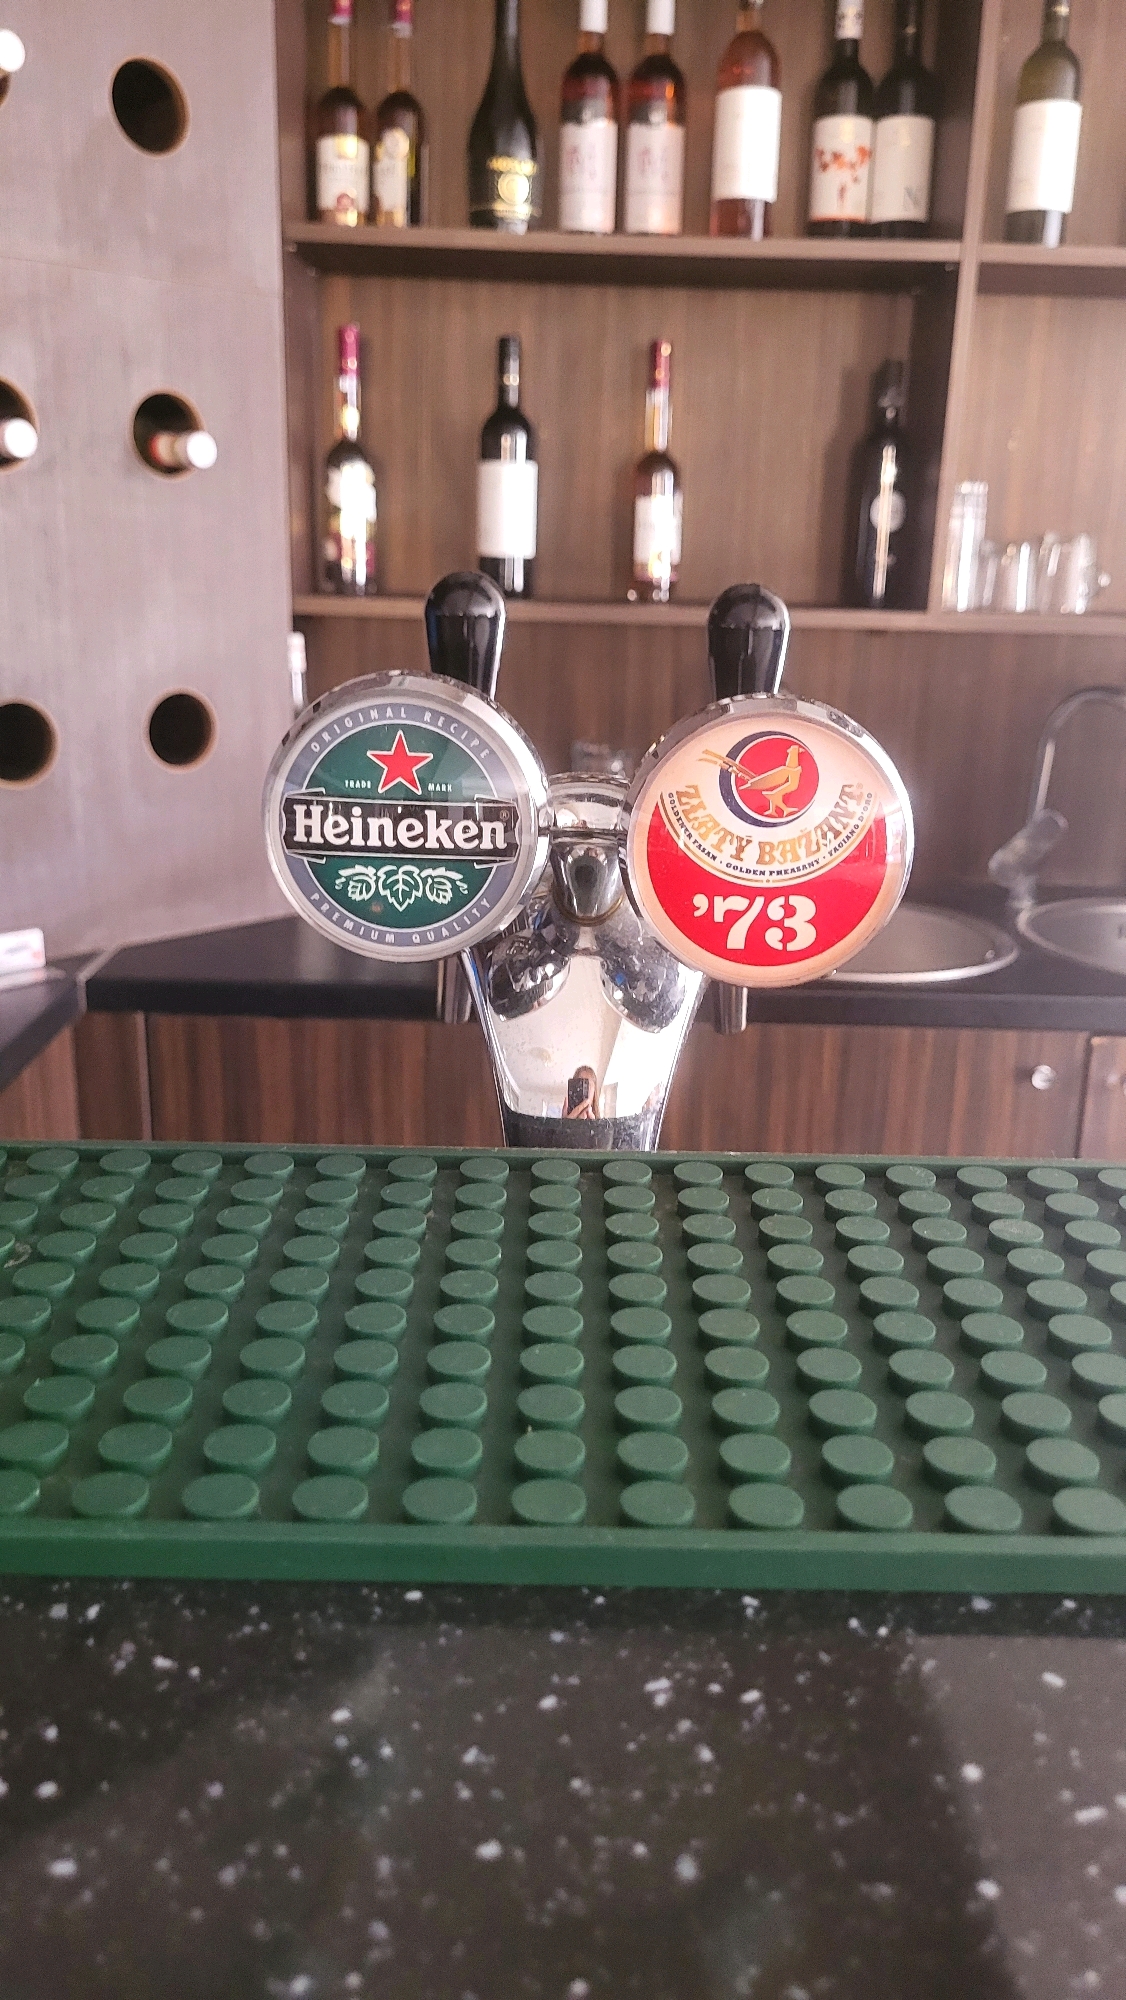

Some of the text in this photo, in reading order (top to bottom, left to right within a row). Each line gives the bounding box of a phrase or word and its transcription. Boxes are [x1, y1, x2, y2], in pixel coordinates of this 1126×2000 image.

[310, 706, 490, 759] ORIGINAL RECIPE
[344, 779, 453, 792] TRADE MARK
[292, 803, 508, 850] Heineken
[692, 838, 718, 862] FASAN
[725, 862, 766, 876] GOLDEN
[857, 792, 873, 823] D'ORO
[309, 892, 491, 945] PREMIUM QUALITY
[691, 893, 818, 952] '73
